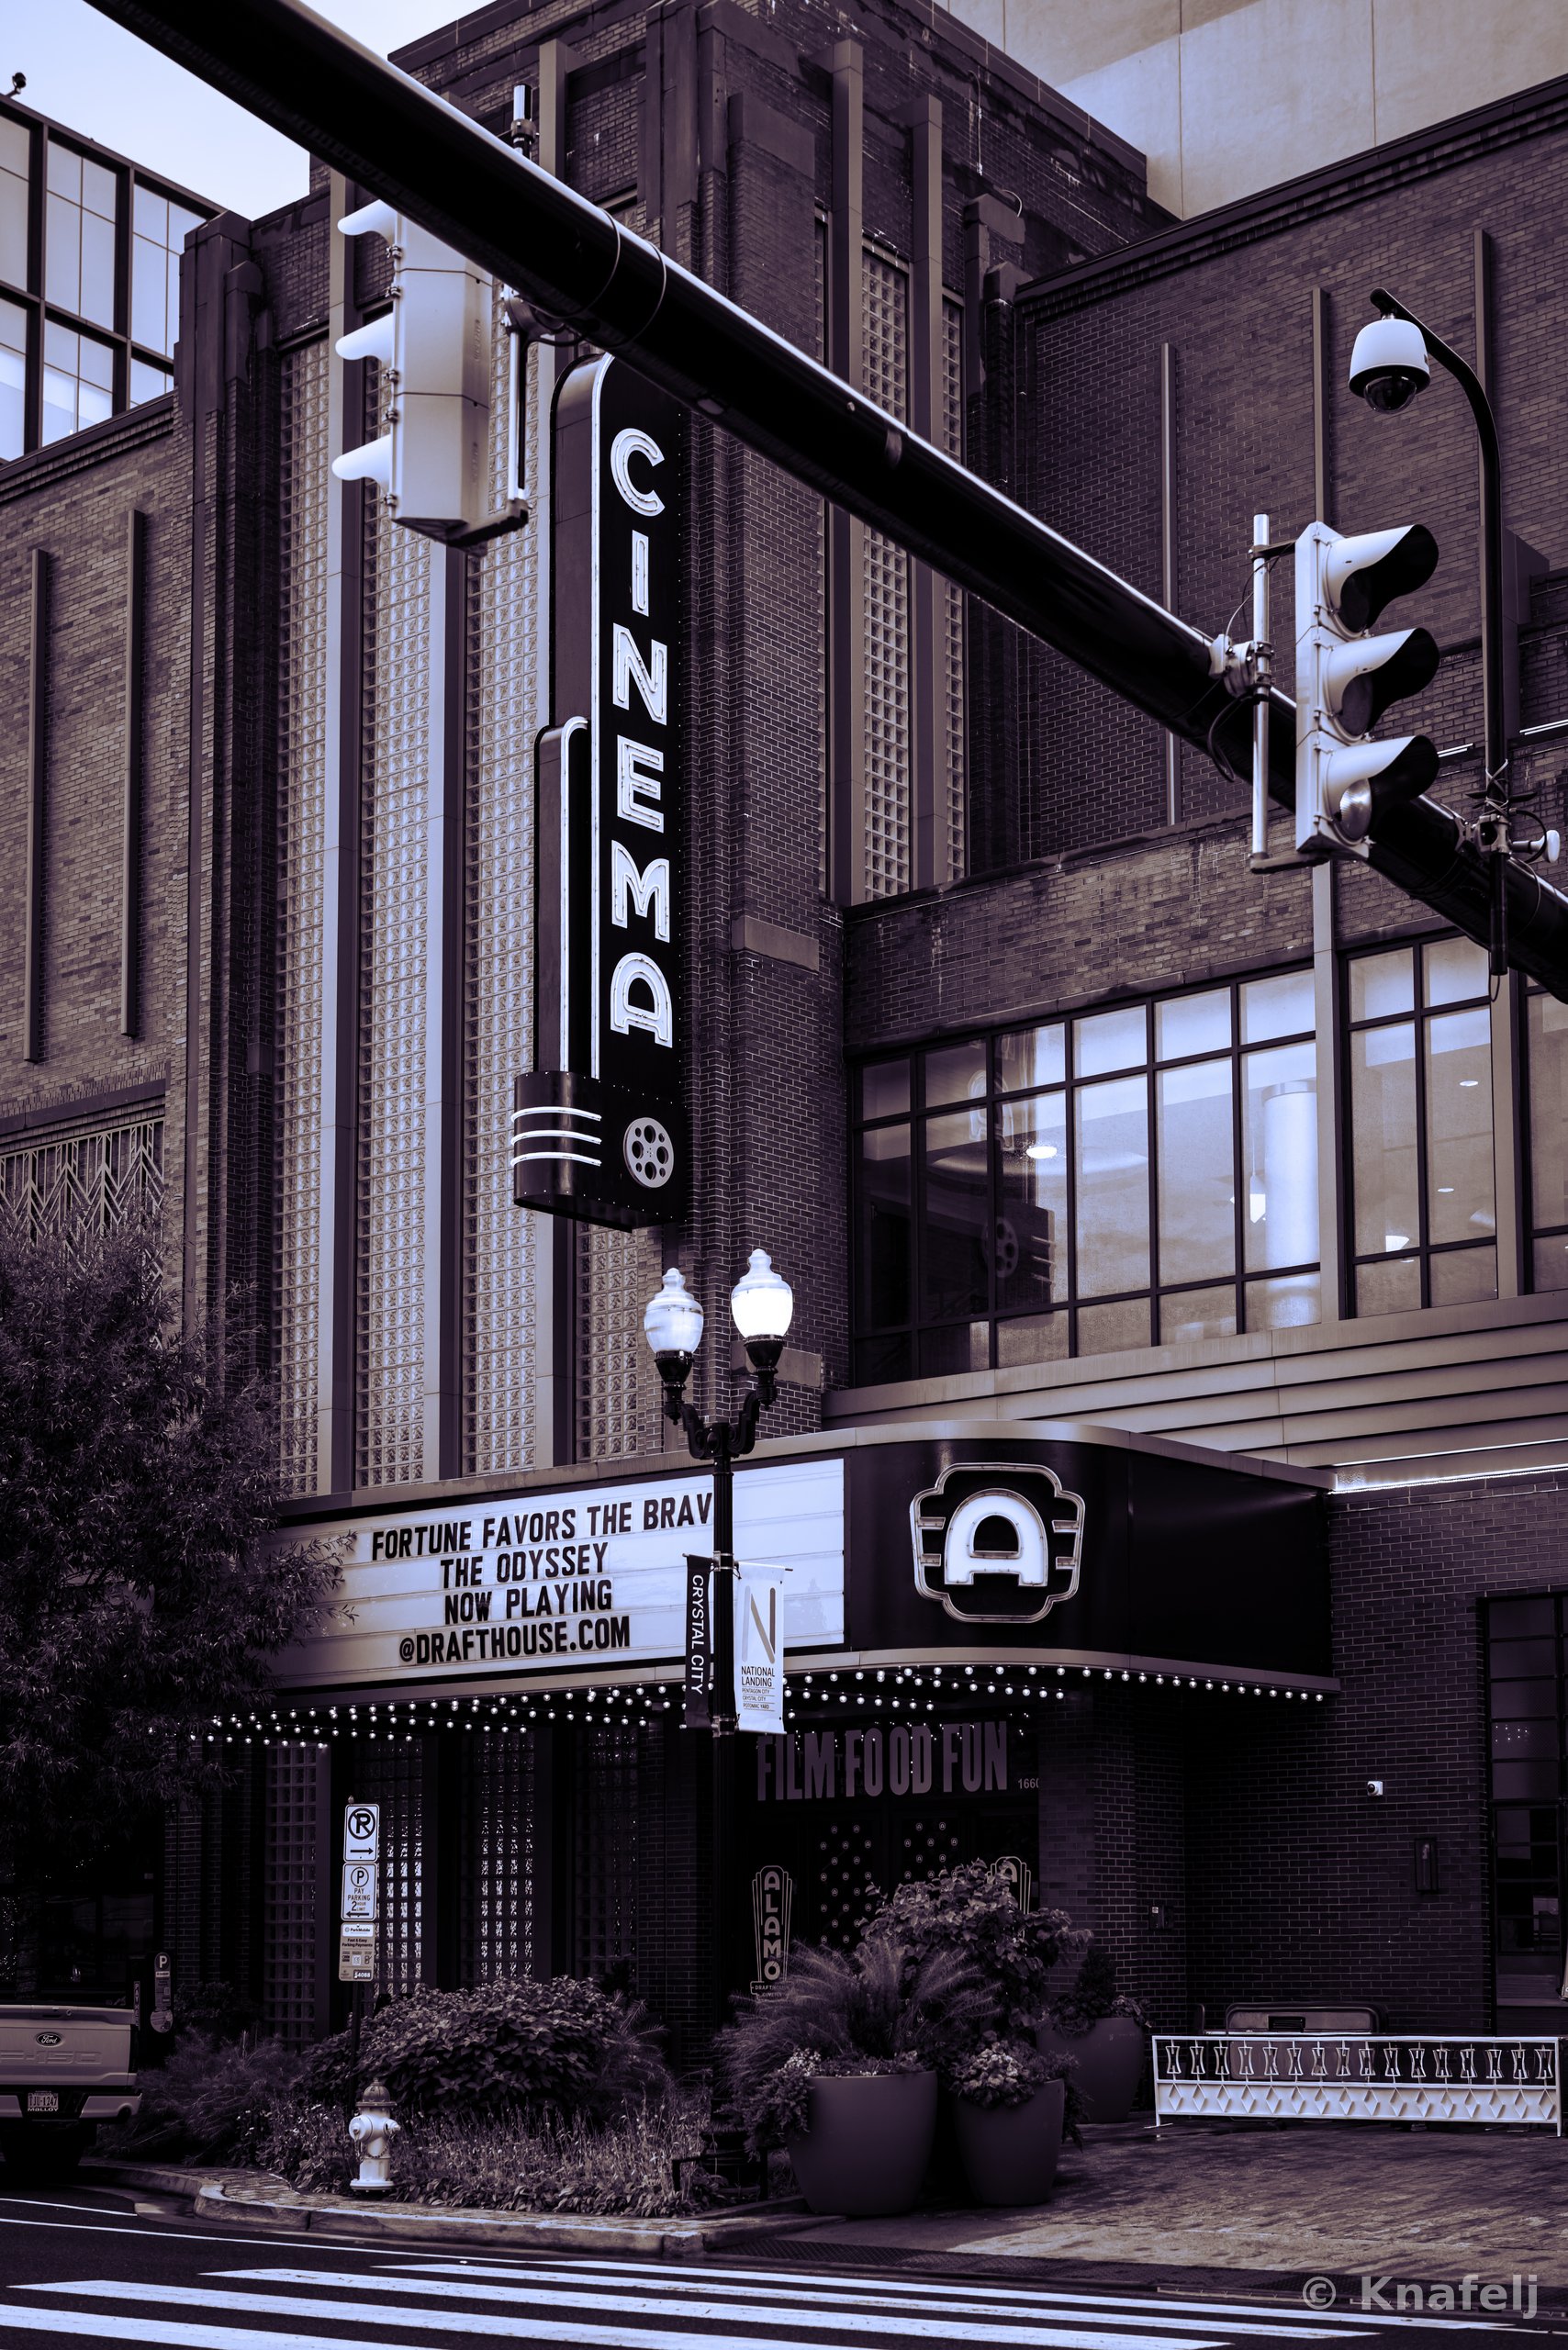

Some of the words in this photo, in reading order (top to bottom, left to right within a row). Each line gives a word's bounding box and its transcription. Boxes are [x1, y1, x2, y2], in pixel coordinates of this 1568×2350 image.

[610, 428, 672, 1047] CINEMA
[373, 1521, 471, 1561] FORTUNE
[483, 1508, 576, 1548] FAVORS
[587, 1502, 632, 1536] THE
[643, 1493, 712, 1530] BRAV
[945, 1488, 1048, 1586] A
[441, 1556, 483, 1588] THE
[497, 1542, 608, 1583] ODYSSEY
[444, 1591, 492, 1625] NOW
[506, 1579, 612, 1618] PLAYING
[691, 1574, 704, 1650] CRYSTAL
[399, 1616, 630, 1664] @DRAFTHOUSE.COM
[690, 1655, 704, 1695] CITY
[741, 1665, 775, 1677] NATIONAL
[742, 1676, 772, 1687] LANDING
[756, 1731, 834, 1801] FILM
[846, 1725, 932, 1797] FOOD
[943, 1721, 1007, 1792] FUN
[356, 1870, 364, 1885] P
[352, 1901, 357, 1911] 2
[763, 1871, 781, 1980] ALAMO
[40, 2034, 58, 2044] Ford
